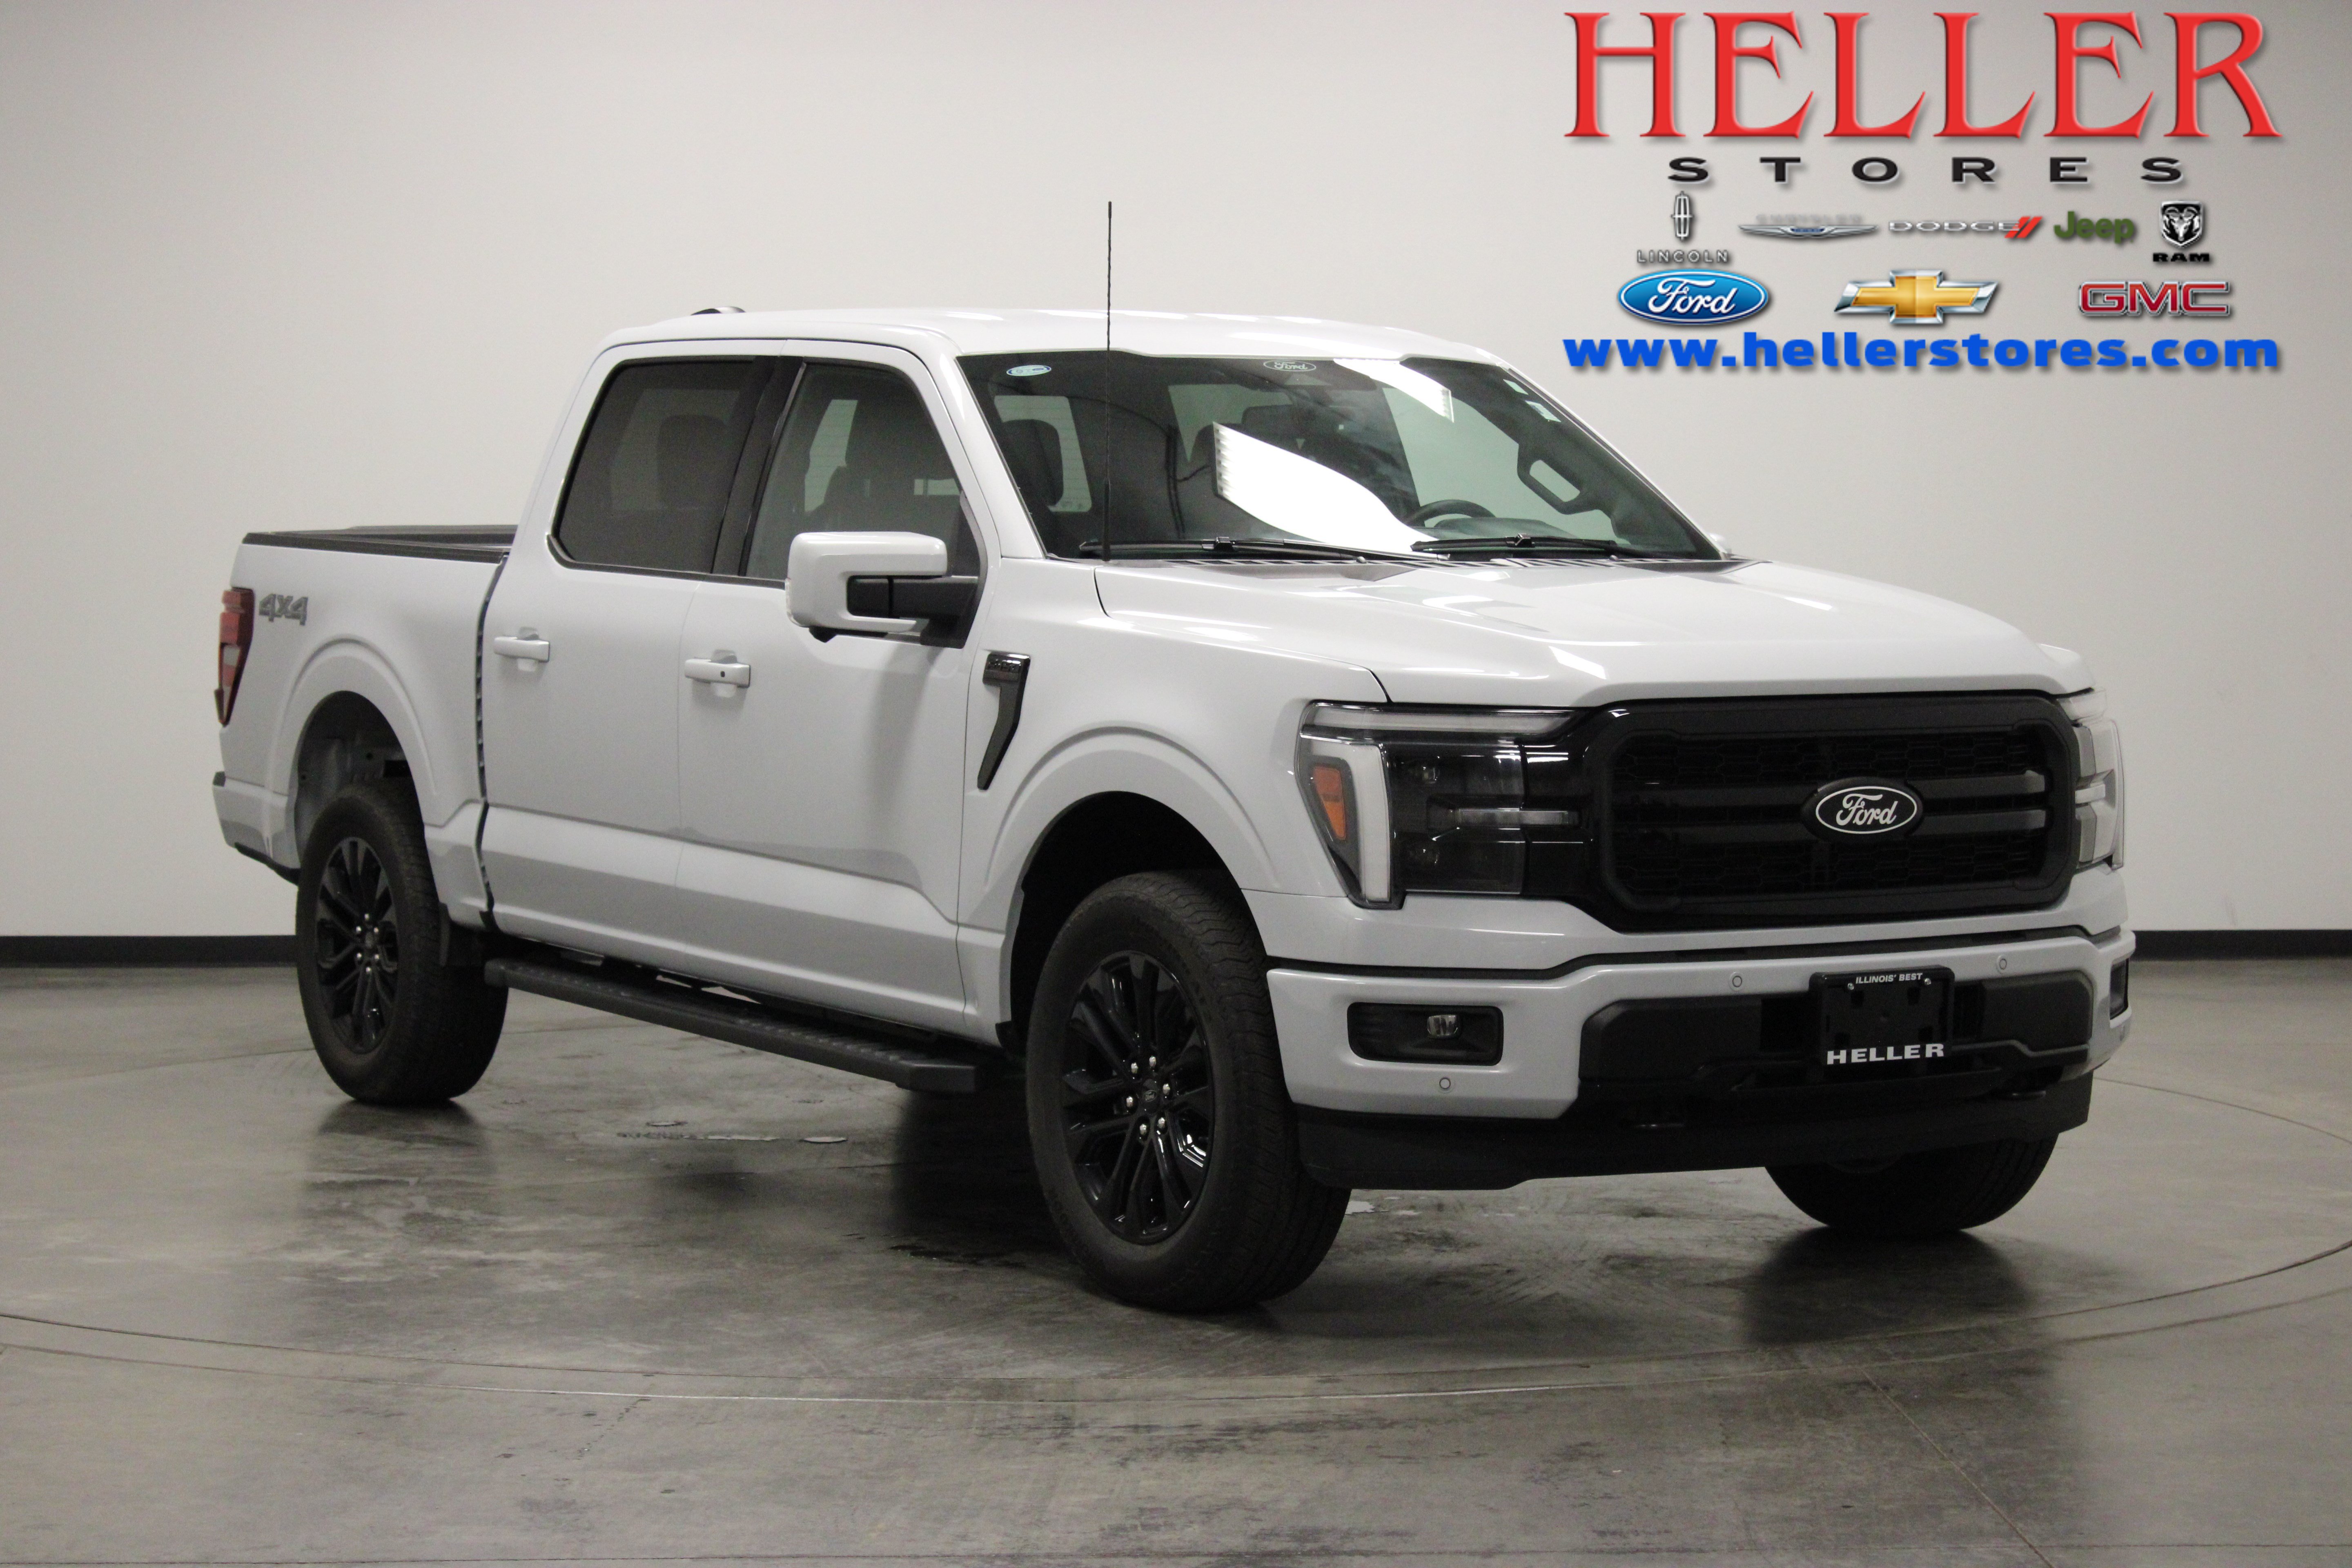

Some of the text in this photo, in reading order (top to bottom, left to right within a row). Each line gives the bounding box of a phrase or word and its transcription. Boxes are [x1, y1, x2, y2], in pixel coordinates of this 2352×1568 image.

[1274, 361, 1308, 370] Ford
[1836, 793, 1898, 826] Ford
[1855, 973, 1923, 984] ILLINOIS' BEST
[1827, 1043, 1944, 1065] HELLER
